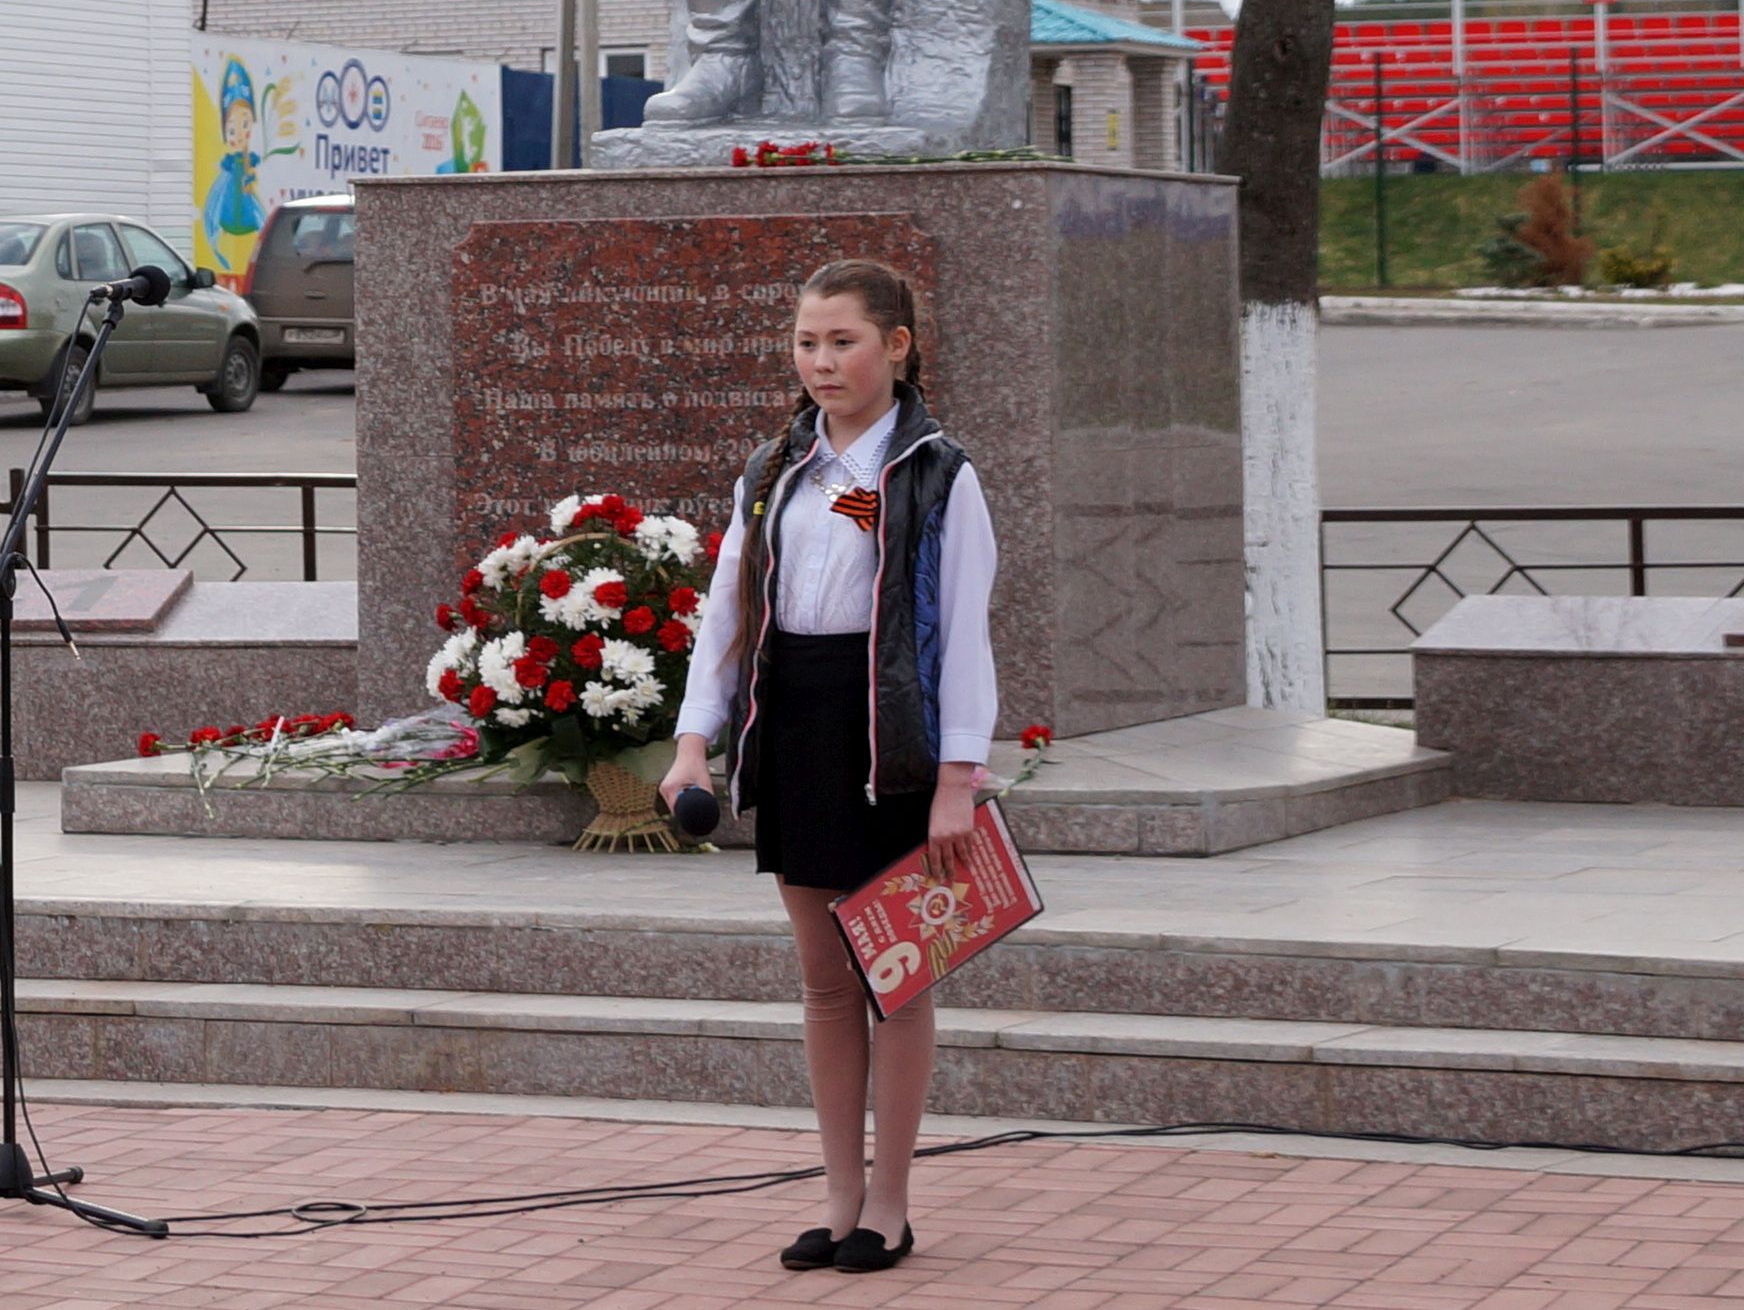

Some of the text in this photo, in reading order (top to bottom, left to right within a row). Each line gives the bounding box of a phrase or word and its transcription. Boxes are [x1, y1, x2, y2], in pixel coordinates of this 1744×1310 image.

[316, 133, 390, 180] Привет
[484, 388, 556, 410] Наша
[848, 915, 922, 994] 9 МАЯ!
